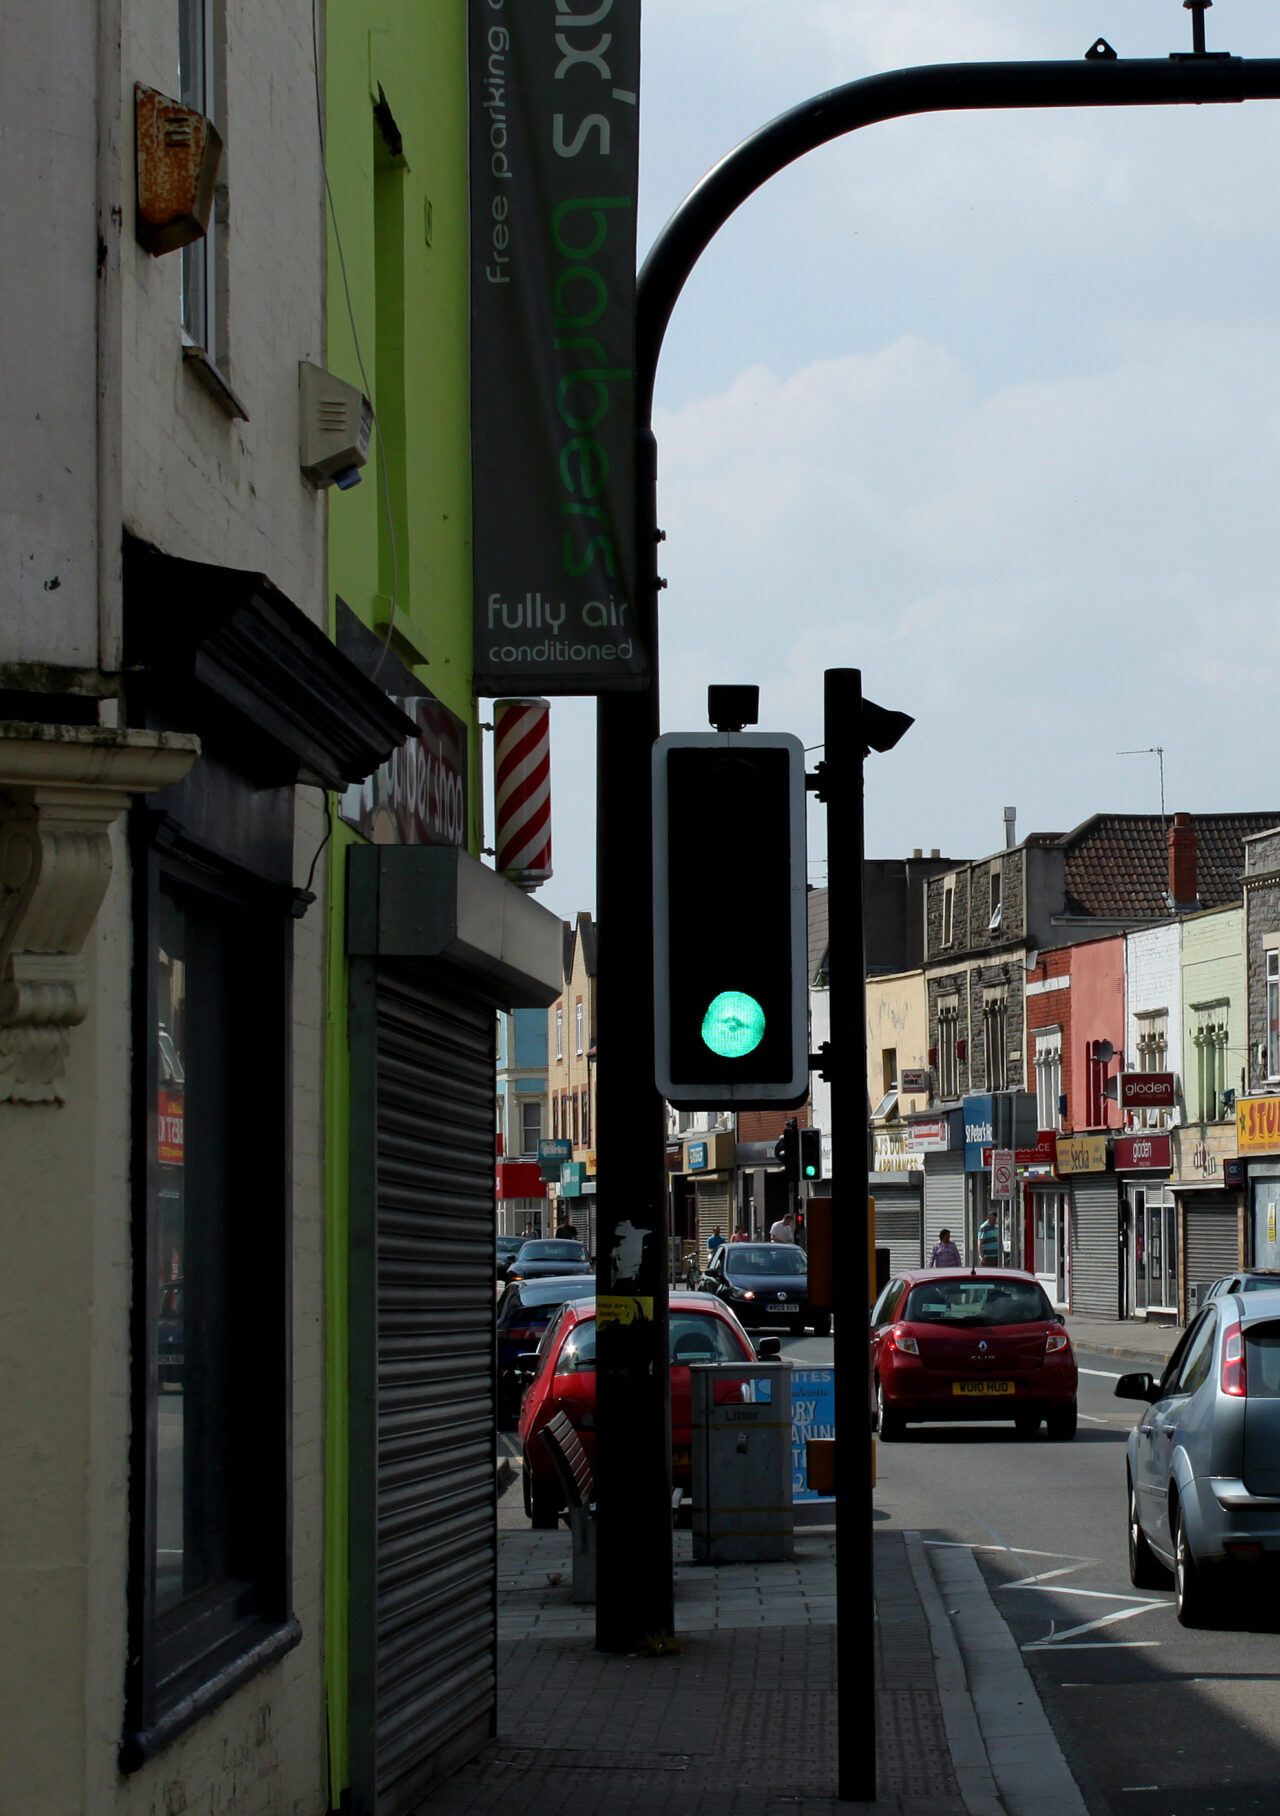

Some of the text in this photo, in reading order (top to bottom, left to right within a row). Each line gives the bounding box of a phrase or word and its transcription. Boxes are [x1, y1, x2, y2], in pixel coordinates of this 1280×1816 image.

[482, 25, 513, 179] parking
[486, 193, 511, 284] free
[549, 196, 632, 578] barbers
[487, 592, 629, 635] fully air
[488, 638, 634, 662] conditioned
[1125, 1083, 1171, 1097] gloden
[792, 1401, 817, 1420] RY
